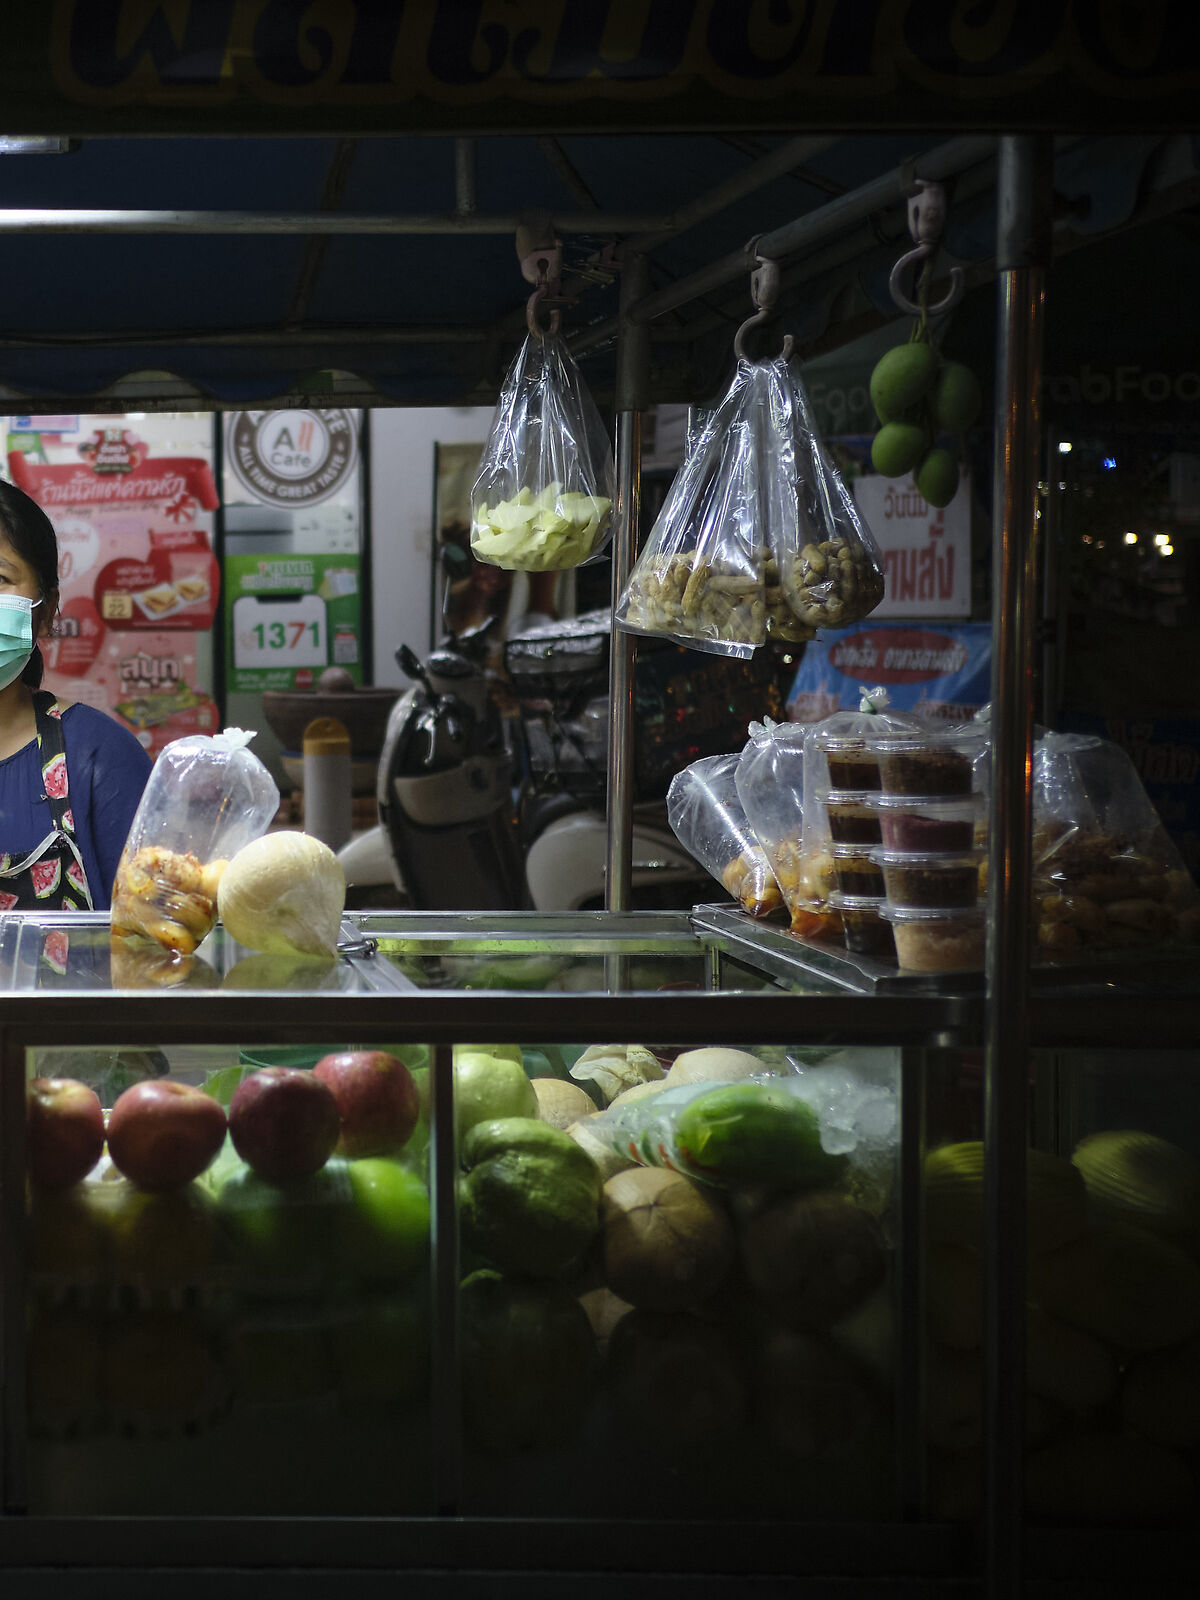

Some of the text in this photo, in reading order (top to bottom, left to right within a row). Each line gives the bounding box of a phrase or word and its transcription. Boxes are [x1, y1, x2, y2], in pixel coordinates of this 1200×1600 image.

[271, 452, 311, 467] Cafe
[276, 481, 318, 498] GREAT
[252, 620, 320, 650] 1371
